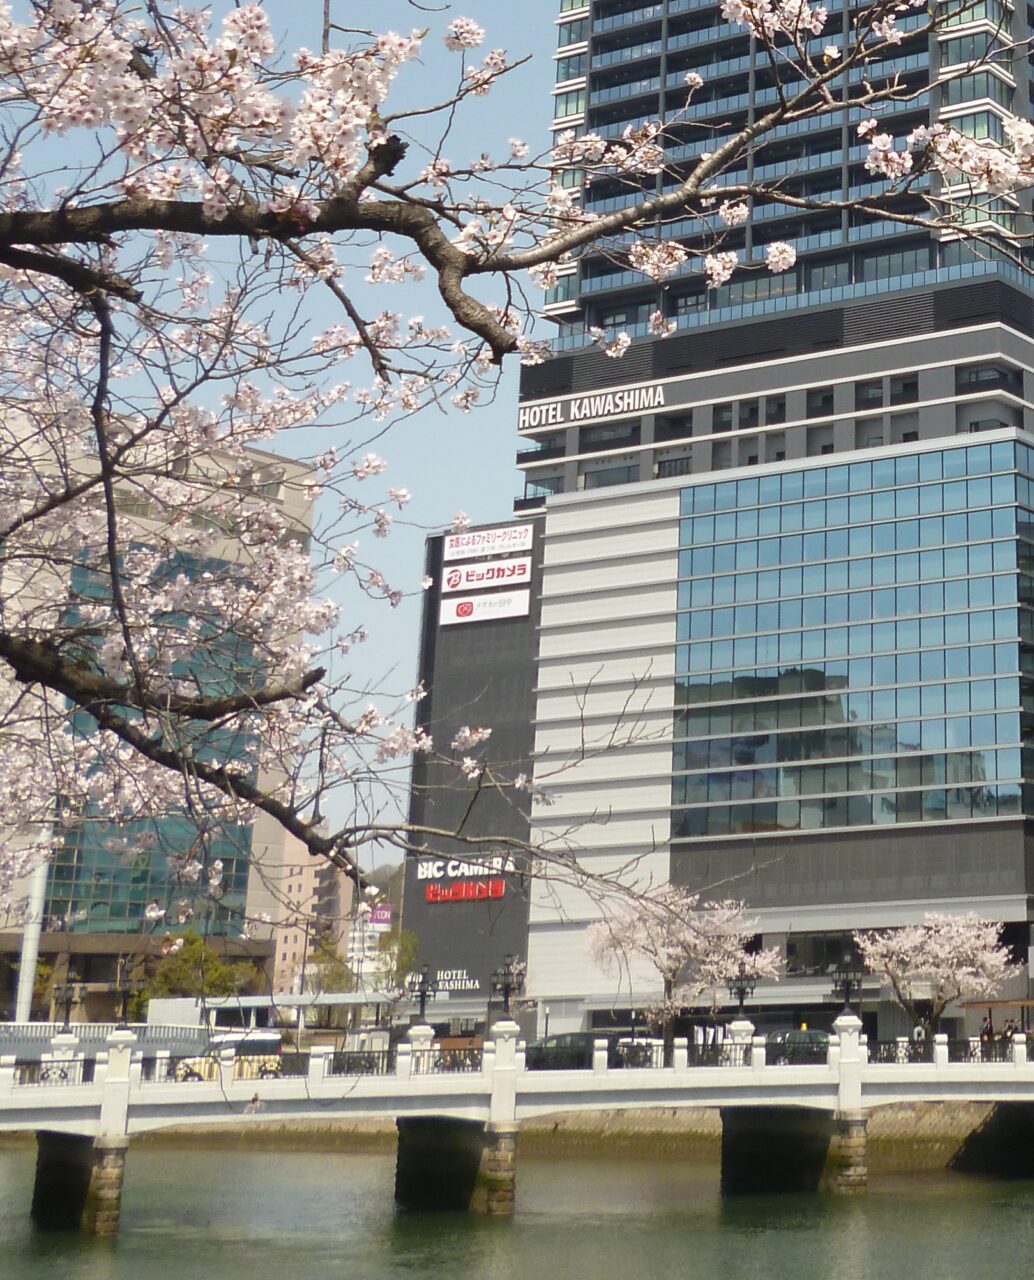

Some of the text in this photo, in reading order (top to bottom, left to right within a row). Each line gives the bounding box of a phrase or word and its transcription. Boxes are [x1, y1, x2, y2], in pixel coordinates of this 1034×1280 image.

[519, 386, 665, 428] HOTEL KAWASHIMA
[449, 528, 528, 548] 女医によるファミリークリニック
[466, 564, 527, 582] ビックカメラ
[418, 861, 444, 879] BIC
[437, 970, 469, 981] HOTEL
